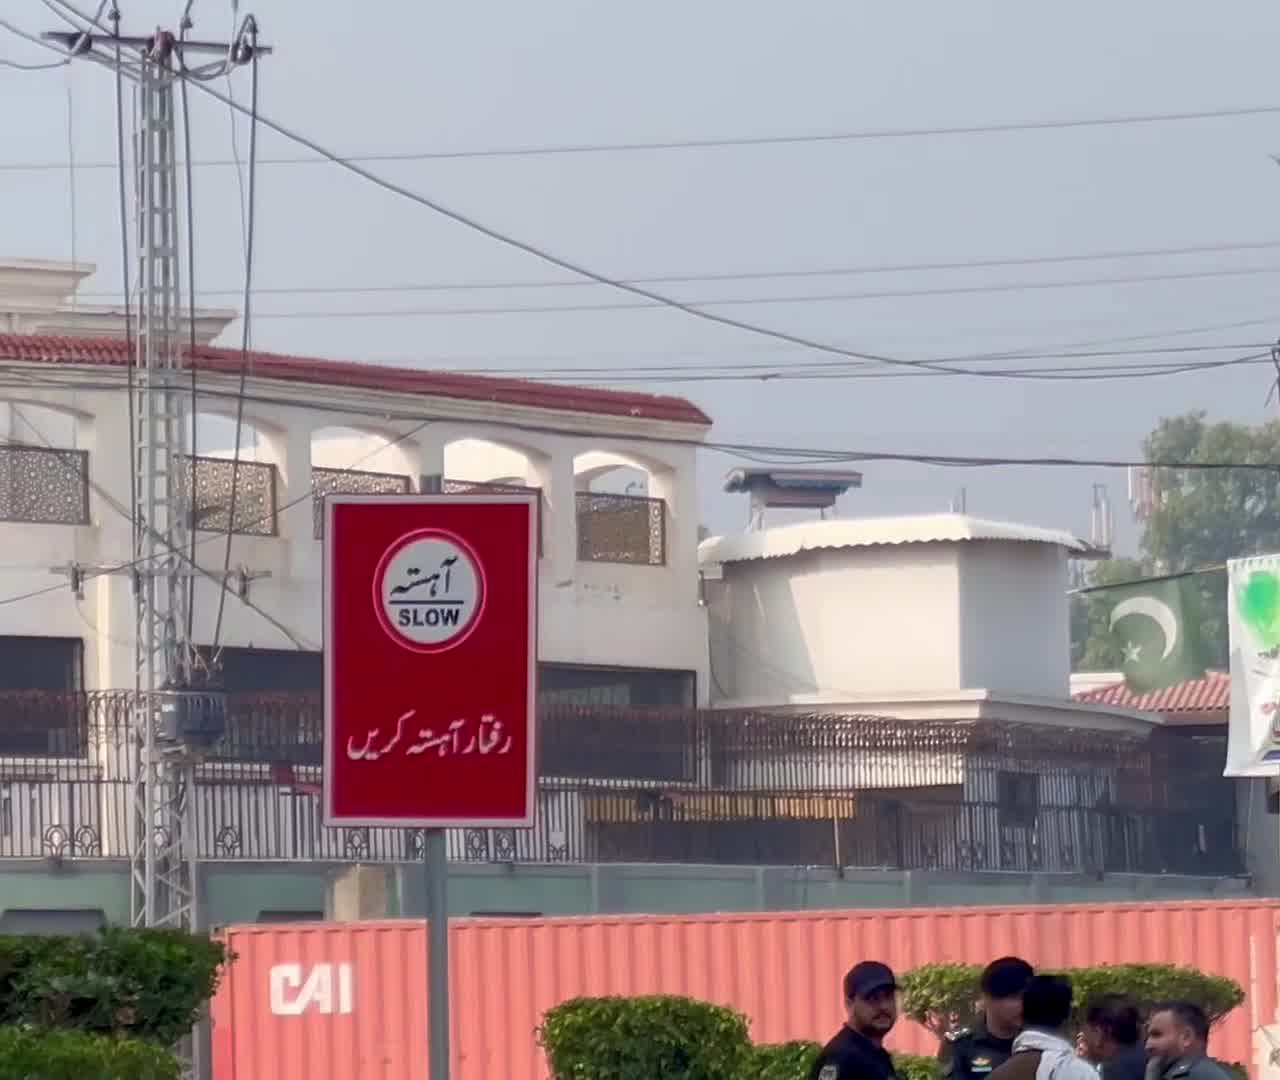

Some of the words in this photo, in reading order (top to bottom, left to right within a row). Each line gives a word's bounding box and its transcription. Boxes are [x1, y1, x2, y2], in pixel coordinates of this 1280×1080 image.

[390, 556, 458, 597] آہستہ
[398, 607, 460, 627] SLOW
[346, 708, 417, 761] کریں
[405, 718, 466, 758] آہستہ
[461, 713, 513, 755] رفتار
[270, 962, 352, 1015] CAI
